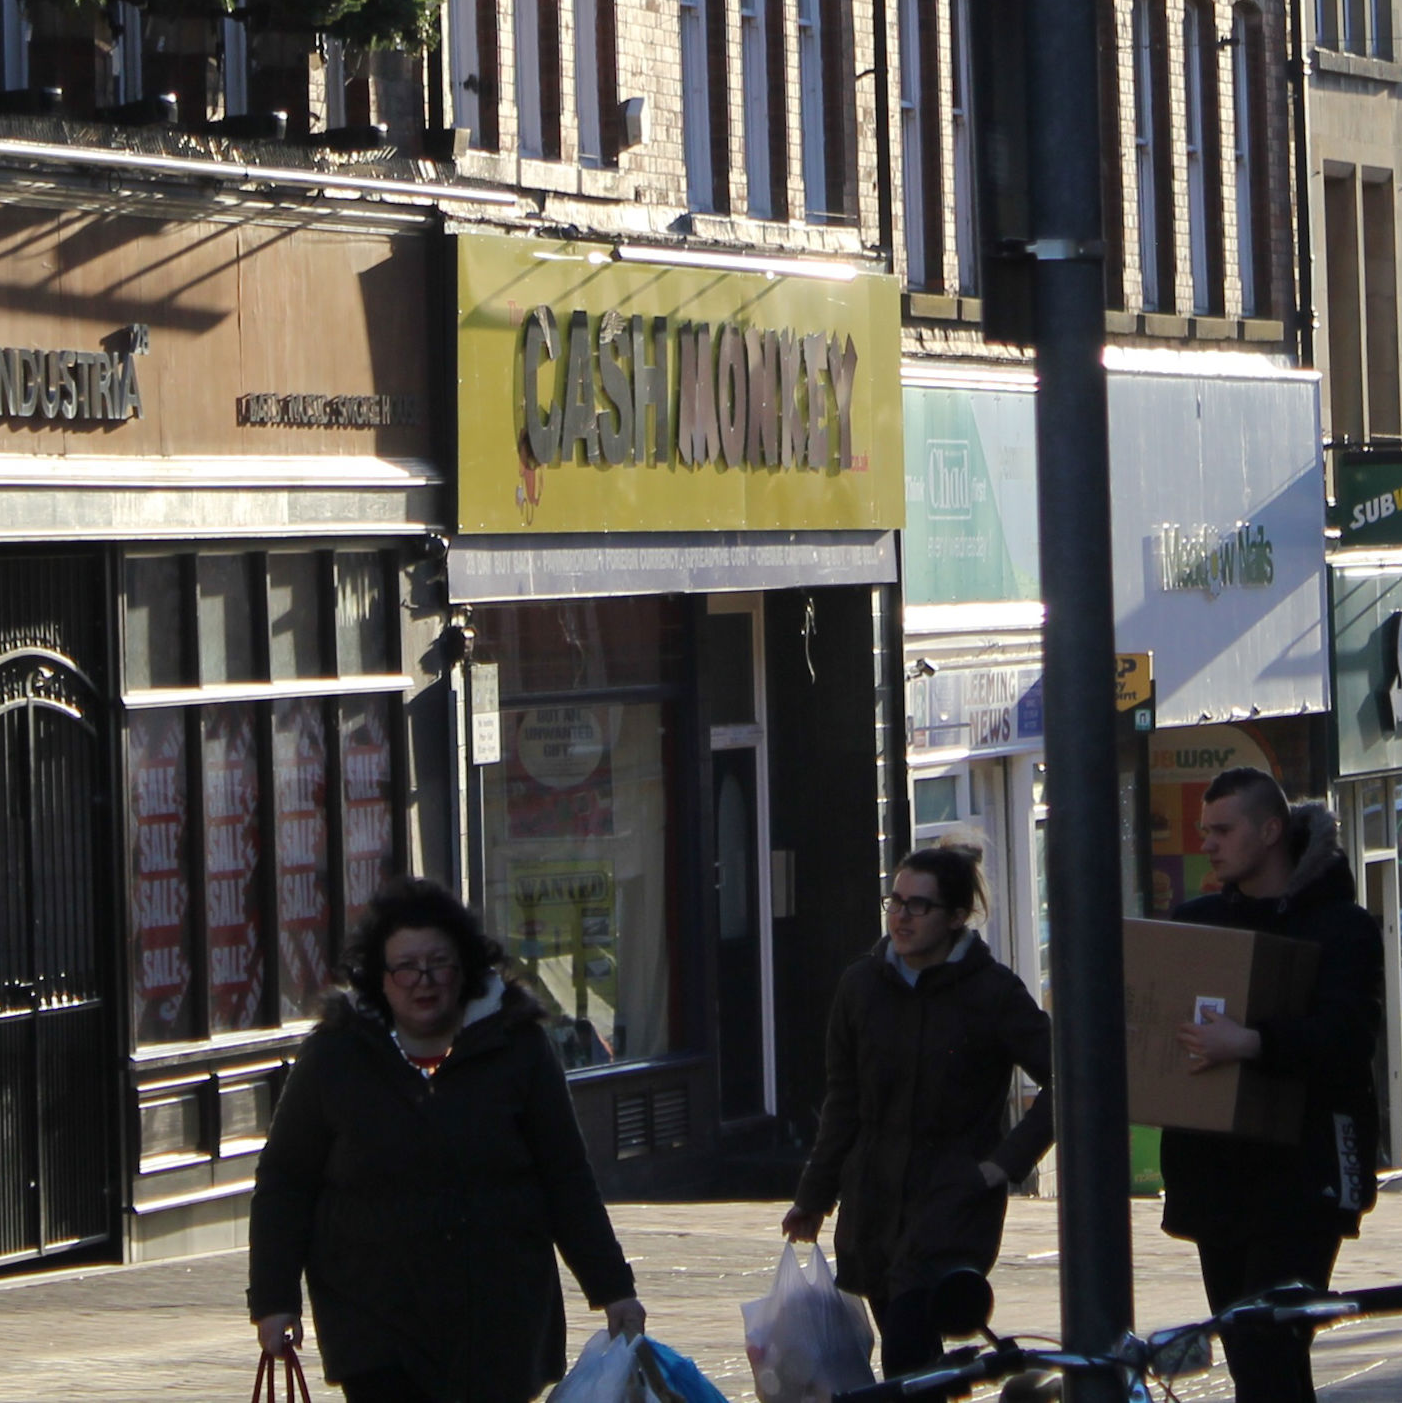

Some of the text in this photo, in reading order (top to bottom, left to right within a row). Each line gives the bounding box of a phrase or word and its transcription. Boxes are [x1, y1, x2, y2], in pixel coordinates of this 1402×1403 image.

[131, 323, 150, 355] 28
[524, 305, 858, 471] CASH MONKEY
[928, 448, 969, 509] Chad
[969, 706, 1011, 747] NEWS
[1150, 746, 1236, 769] UBWAY
[139, 824, 179, 873] SALE
[142, 947, 182, 989] SALE
[211, 946, 249, 987] SALE
[1340, 1122, 1362, 1204] adidas
